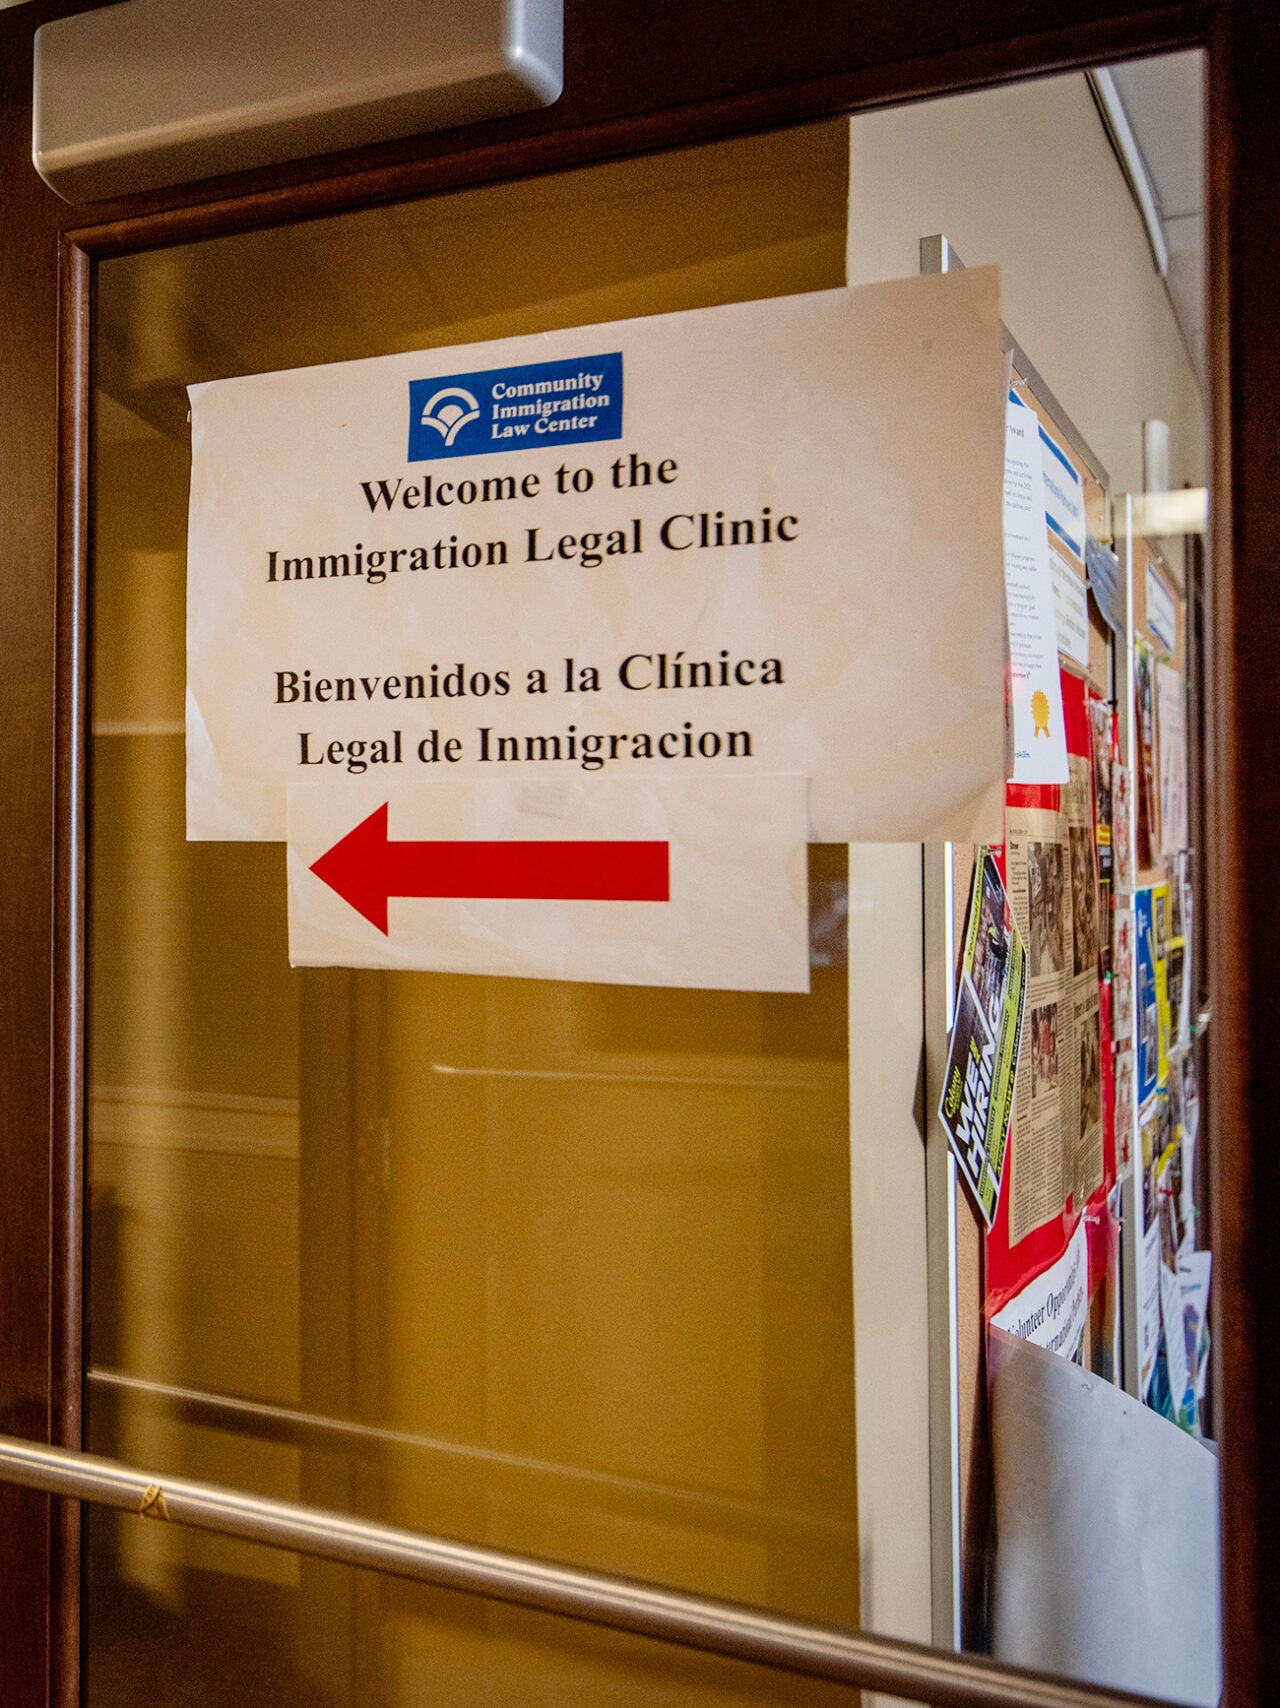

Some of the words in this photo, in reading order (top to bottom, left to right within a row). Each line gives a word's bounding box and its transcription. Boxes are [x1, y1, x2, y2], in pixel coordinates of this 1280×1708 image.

[492, 373, 603, 400] Community
[492, 394, 610, 420] Immigration
[491, 422, 530, 439] Law
[534, 413, 598, 434] Center
[360, 474, 540, 513] Welcome
[554, 464, 594, 495] to
[610, 453, 678, 489] the
[266, 535, 508, 585] Immigration
[525, 518, 643, 569] Legal
[659, 507, 798, 551] Clinic
[274, 663, 510, 704] Bienvenidos
[526, 669, 548, 695] a
[564, 658, 601, 693] la
[618, 650, 784, 691] Clínica
[298, 730, 403, 775] Legal
[417, 729, 462, 764] de
[477, 722, 753, 770] Inmigracion
[967, 993, 1000, 1178] HIRING
